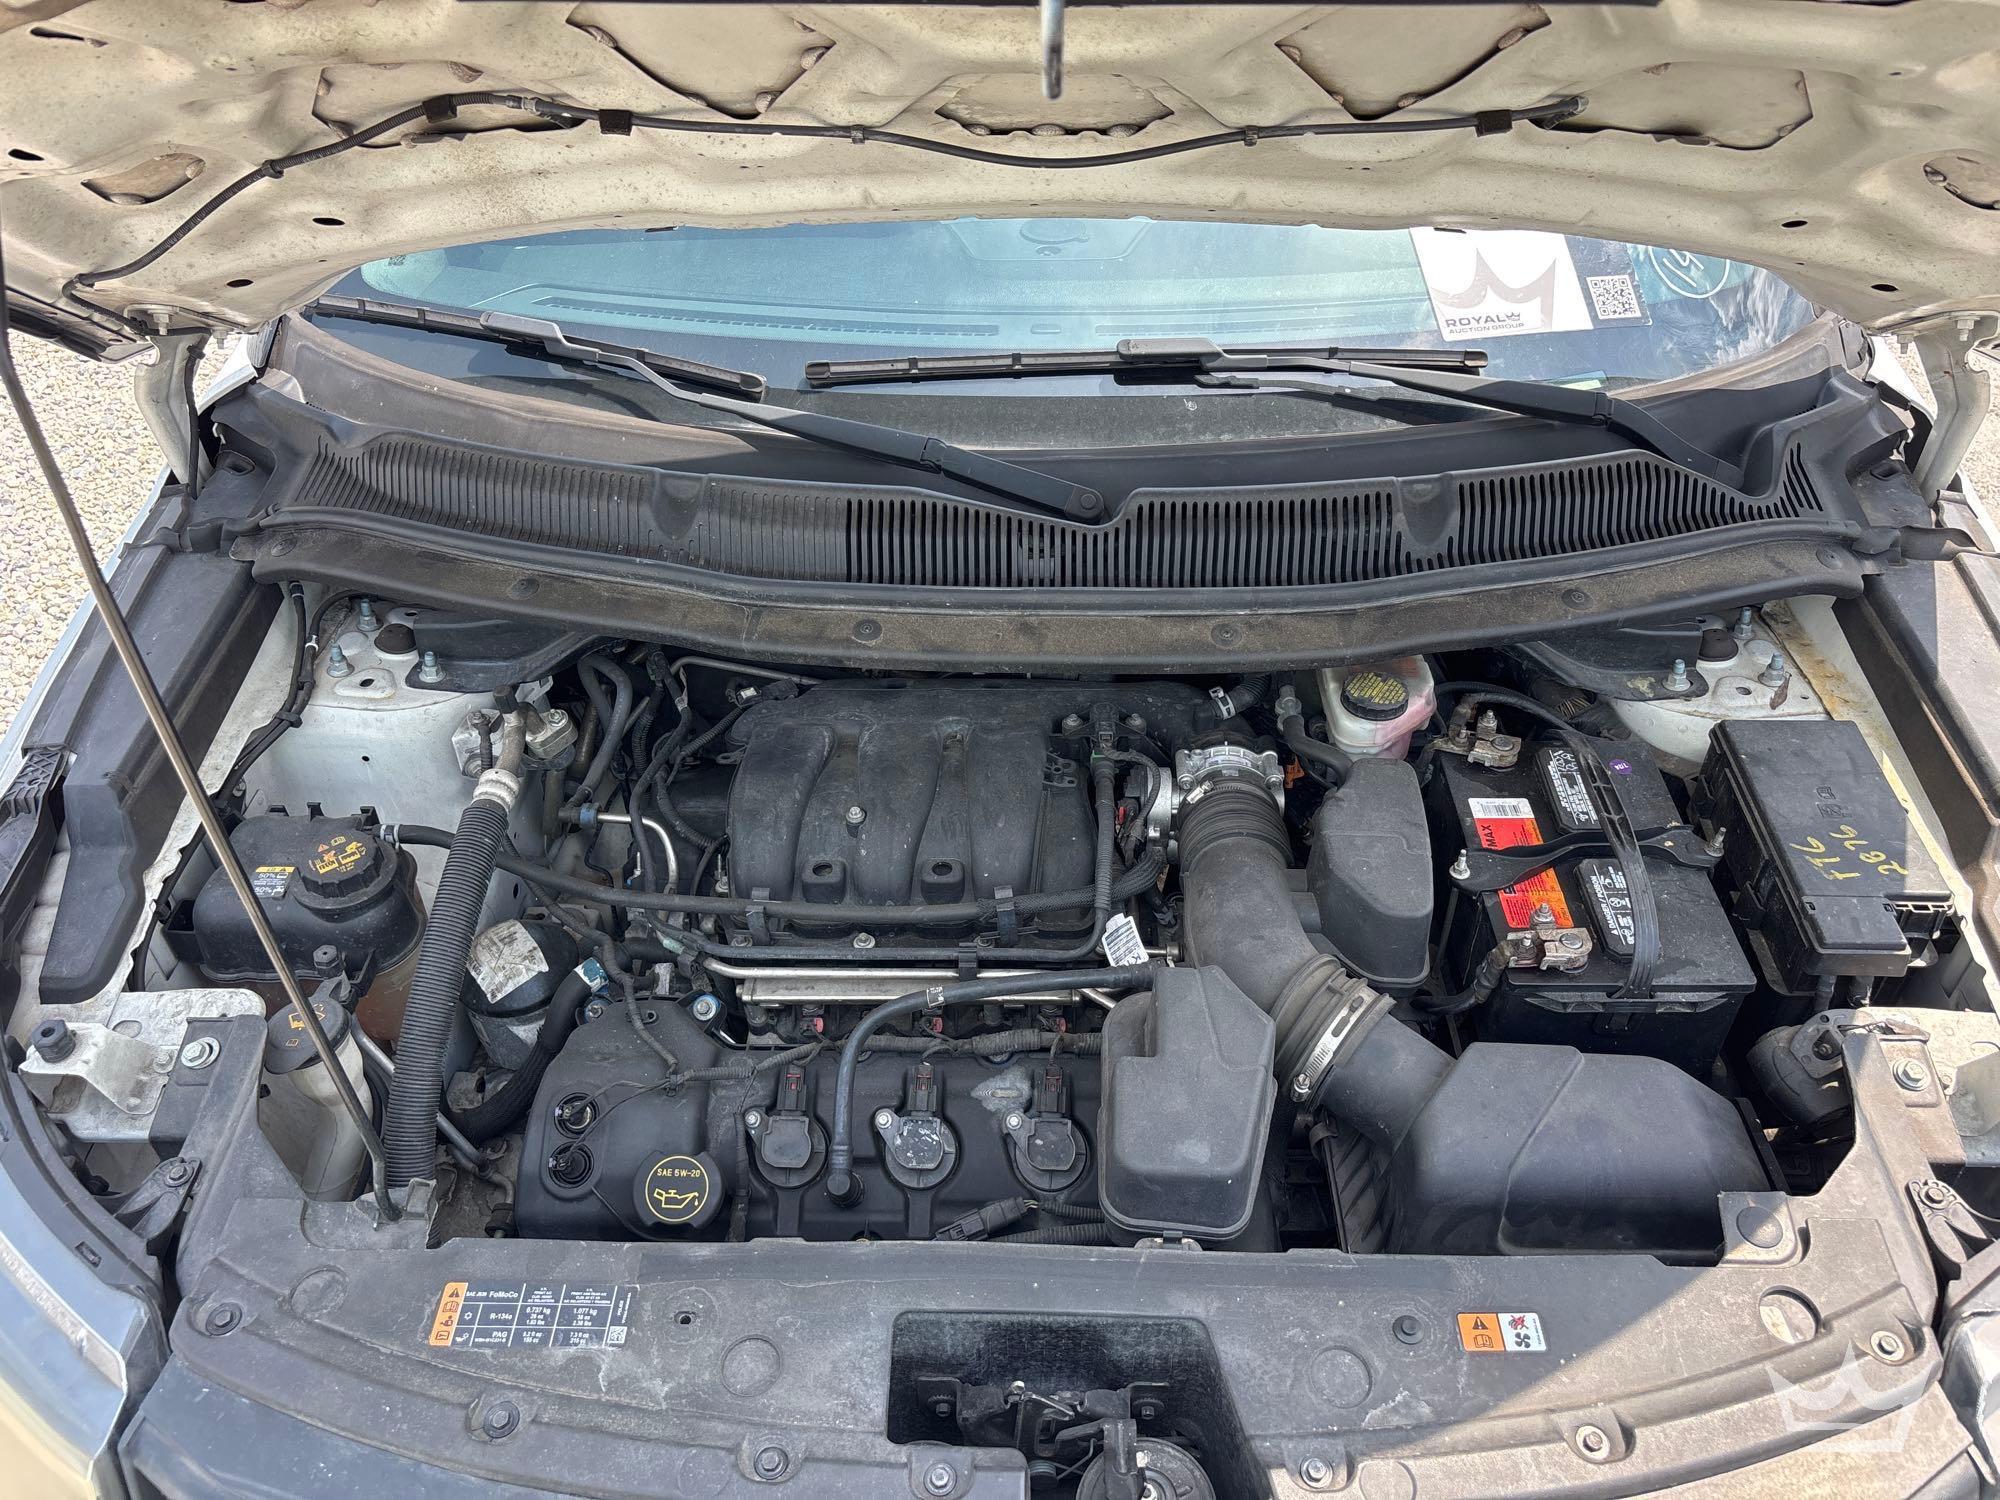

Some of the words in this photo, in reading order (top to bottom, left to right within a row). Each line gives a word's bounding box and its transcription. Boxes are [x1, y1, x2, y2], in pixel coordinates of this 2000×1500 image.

[1445, 314, 1507, 327] ROYAL
[1449, 326, 1490, 334] AUCTION
[1491, 322, 1524, 330] GROUP
[1480, 825, 1498, 848] MAX
[1590, 876, 1604, 898] POISON
[1601, 904, 1616, 929] DANGER
[657, 1168, 672, 1176] SAE
[674, 1169, 701, 1177] 5W-20
[490, 1312, 513, 1320] R-134a
[543, 1306, 551, 1315] kg
